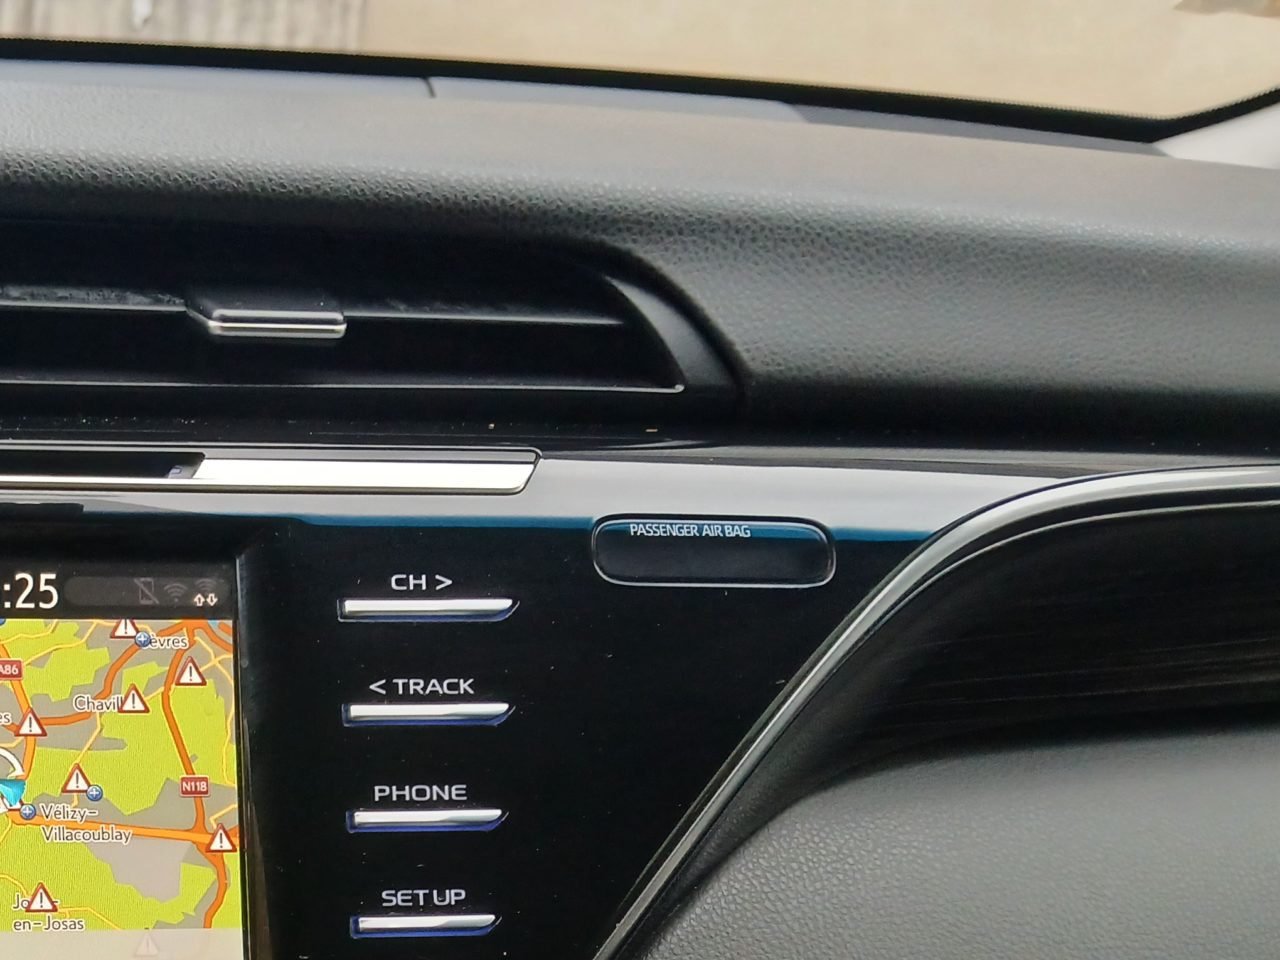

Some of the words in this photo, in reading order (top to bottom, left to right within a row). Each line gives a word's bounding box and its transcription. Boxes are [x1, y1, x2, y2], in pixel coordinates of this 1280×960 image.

[630, 524, 699, 537] PASSENGER
[702, 525, 723, 537] AIR
[725, 525, 751, 538] BAG
[390, 574, 427, 590] CH
[148, 632, 187, 648] èvres
[392, 678, 474, 695] TRACK
[182, 780, 208, 793] N118
[374, 784, 467, 802] PHONE
[40, 804, 97, 821] Vélizy-
[42, 826, 131, 843] Villacoublay
[13, 915, 84, 931] en-Josas
